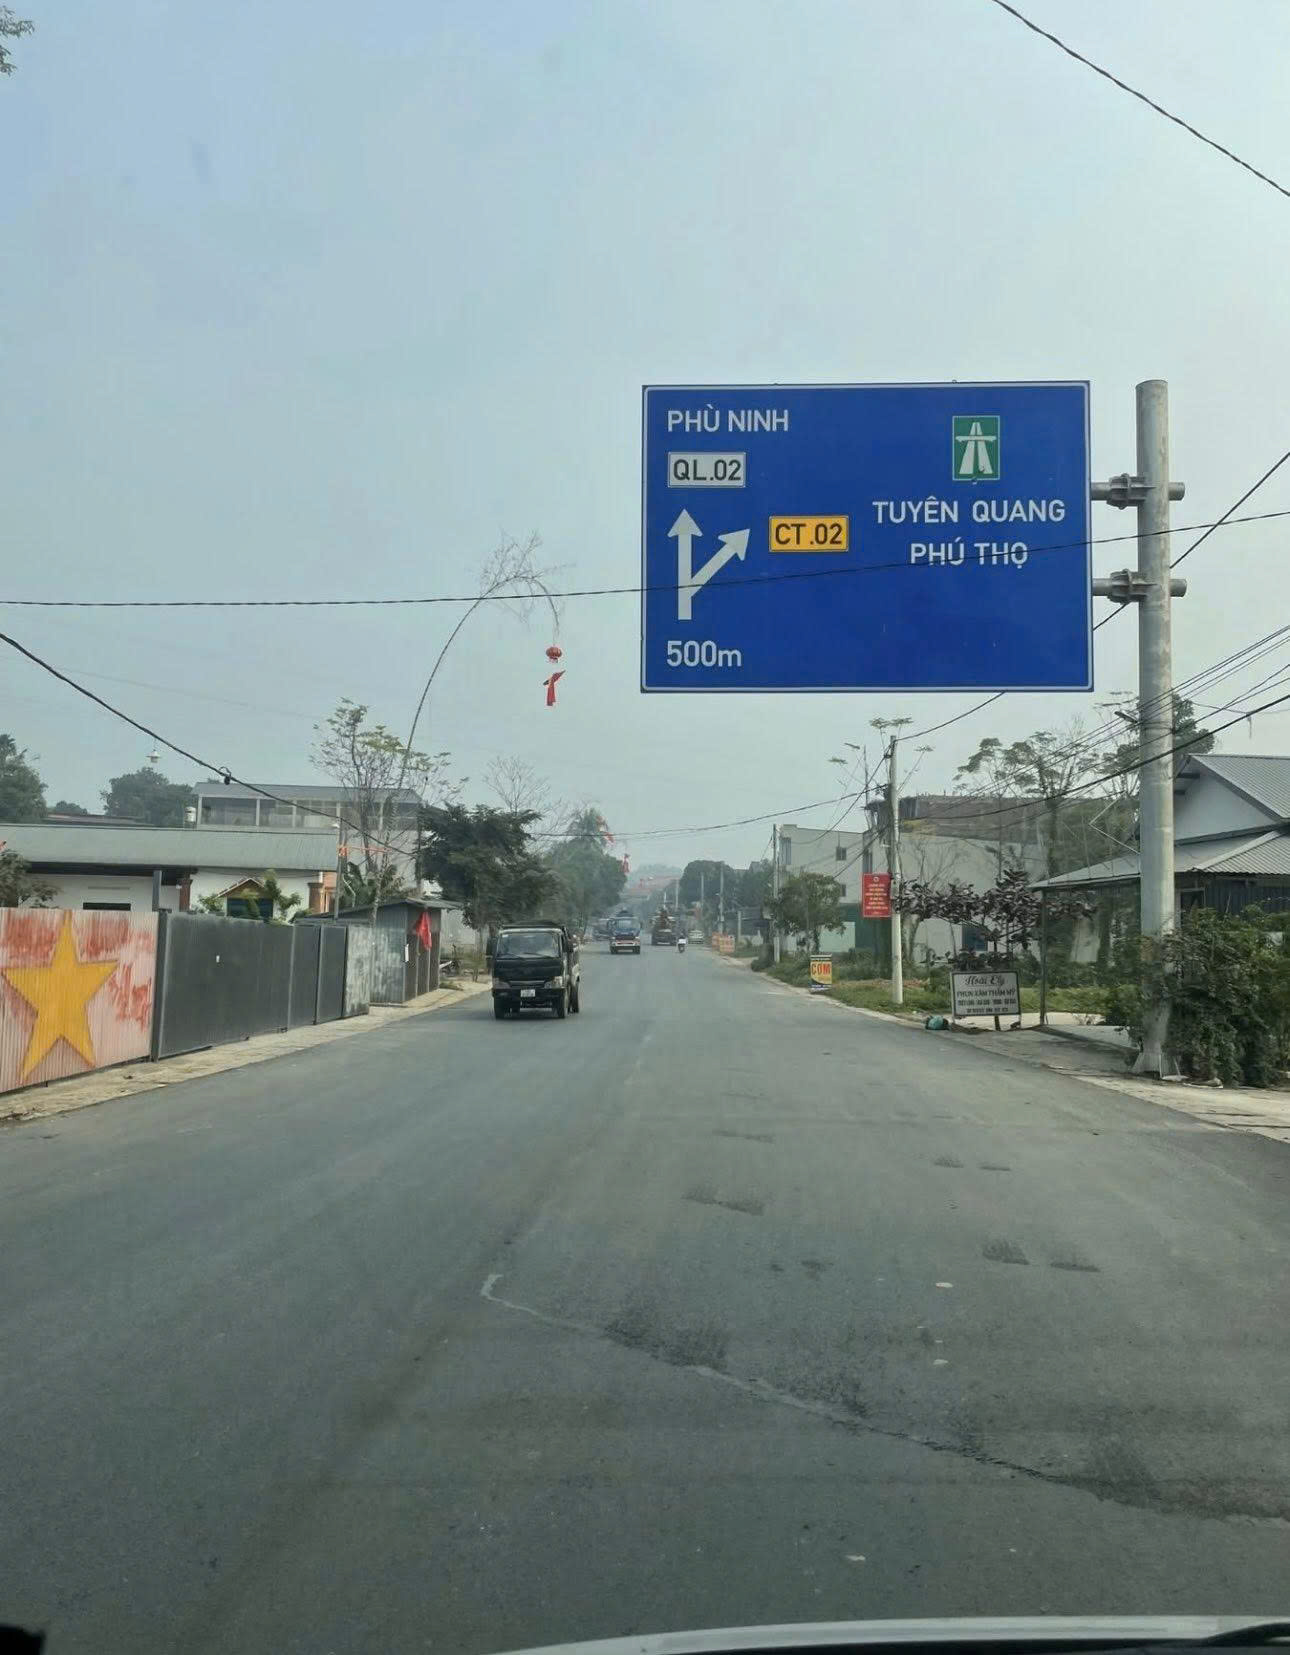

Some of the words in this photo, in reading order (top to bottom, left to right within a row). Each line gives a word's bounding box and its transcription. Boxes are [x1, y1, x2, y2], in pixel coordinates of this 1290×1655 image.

[668, 404, 720, 432] PHÙ
[728, 410, 789, 432] NINH
[673, 459, 742, 481] QL.02
[872, 496, 959, 523] TUYÊN
[972, 499, 1065, 522] QUANG
[775, 523, 842, 545] CT.02
[911, 536, 965, 566] PHÚ
[974, 542, 1028, 569] THỌ
[666, 641, 742, 667] 500m
